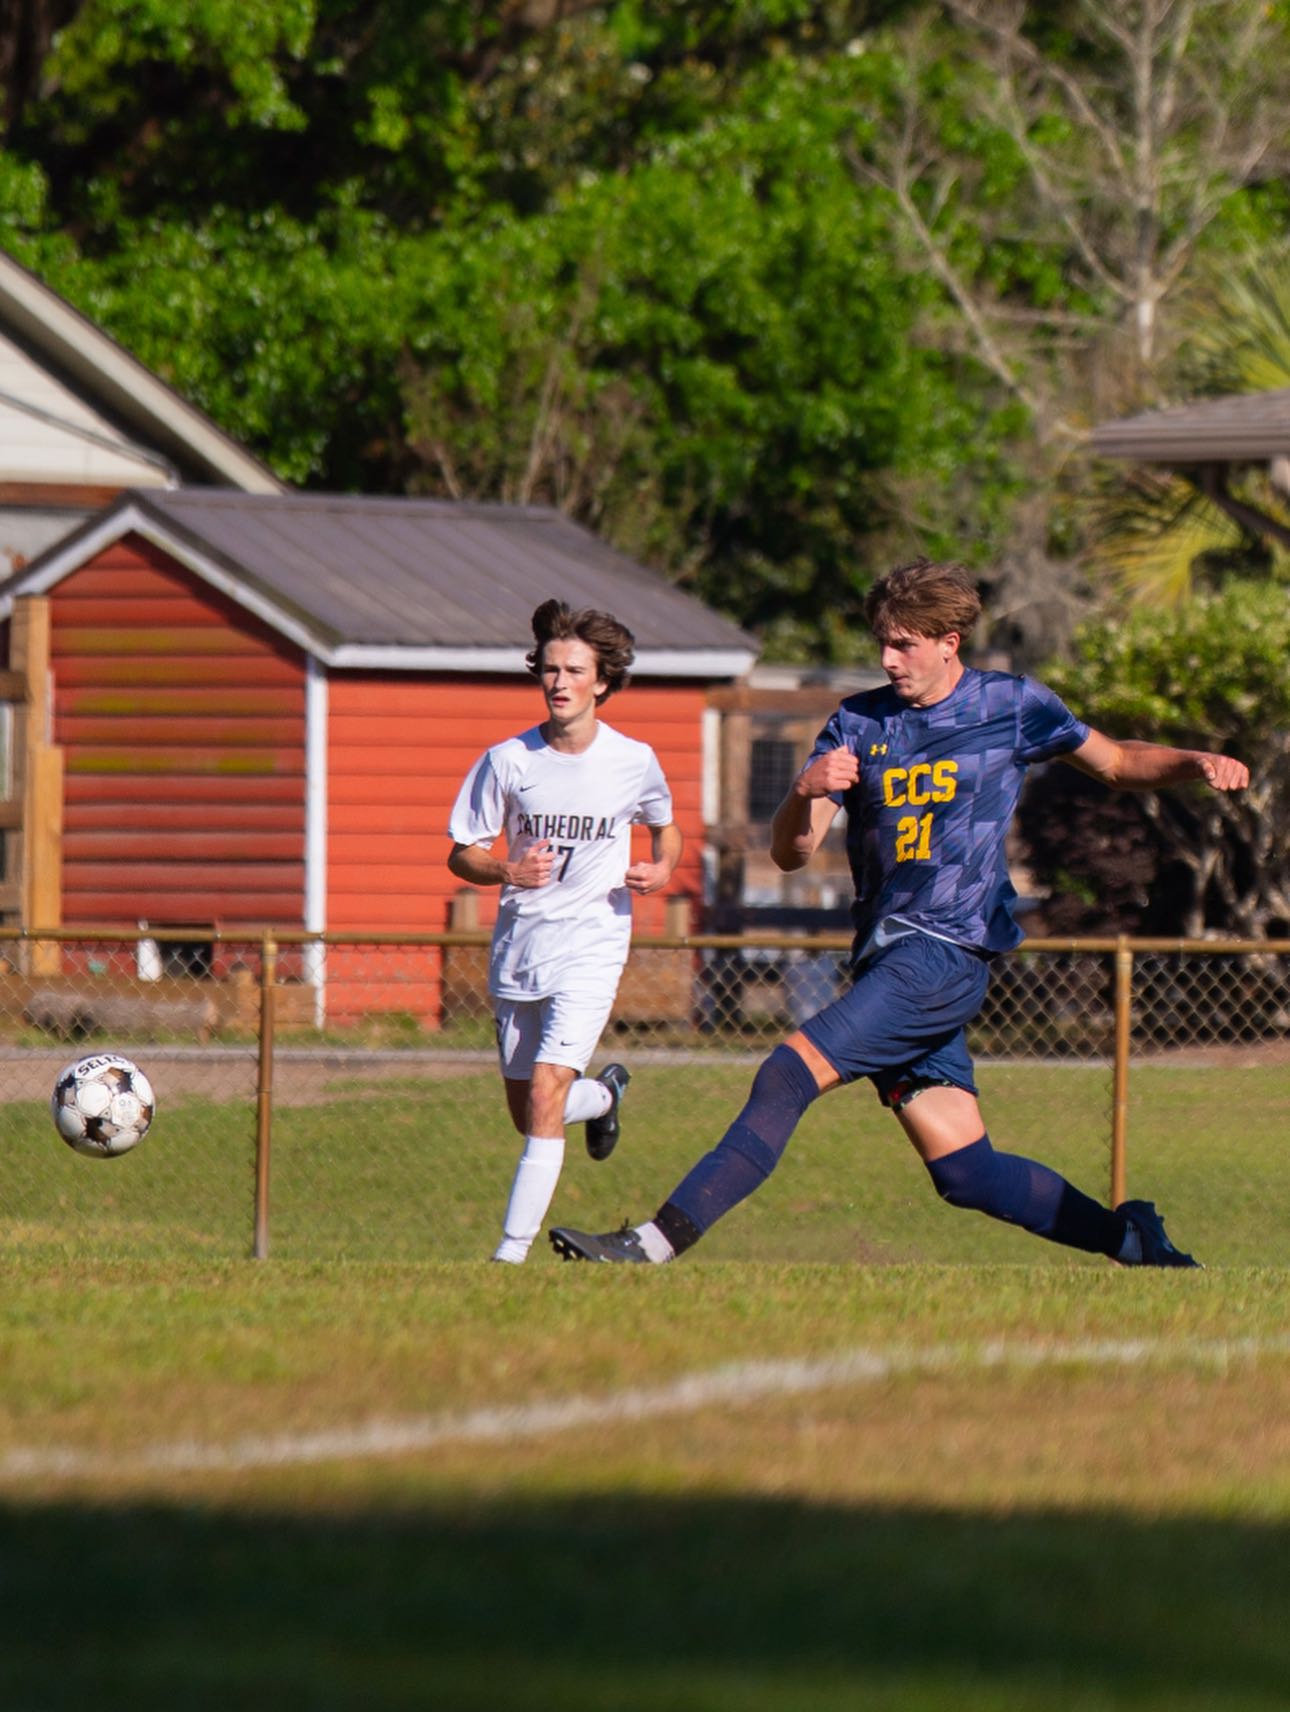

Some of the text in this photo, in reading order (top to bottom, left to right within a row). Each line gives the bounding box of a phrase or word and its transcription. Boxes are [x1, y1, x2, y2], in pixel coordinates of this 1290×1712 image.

[882, 760, 959, 807] CCS
[517, 814, 616, 841] CATHEDRAL
[896, 812, 934, 862] 21
[547, 845, 576, 882] 7
